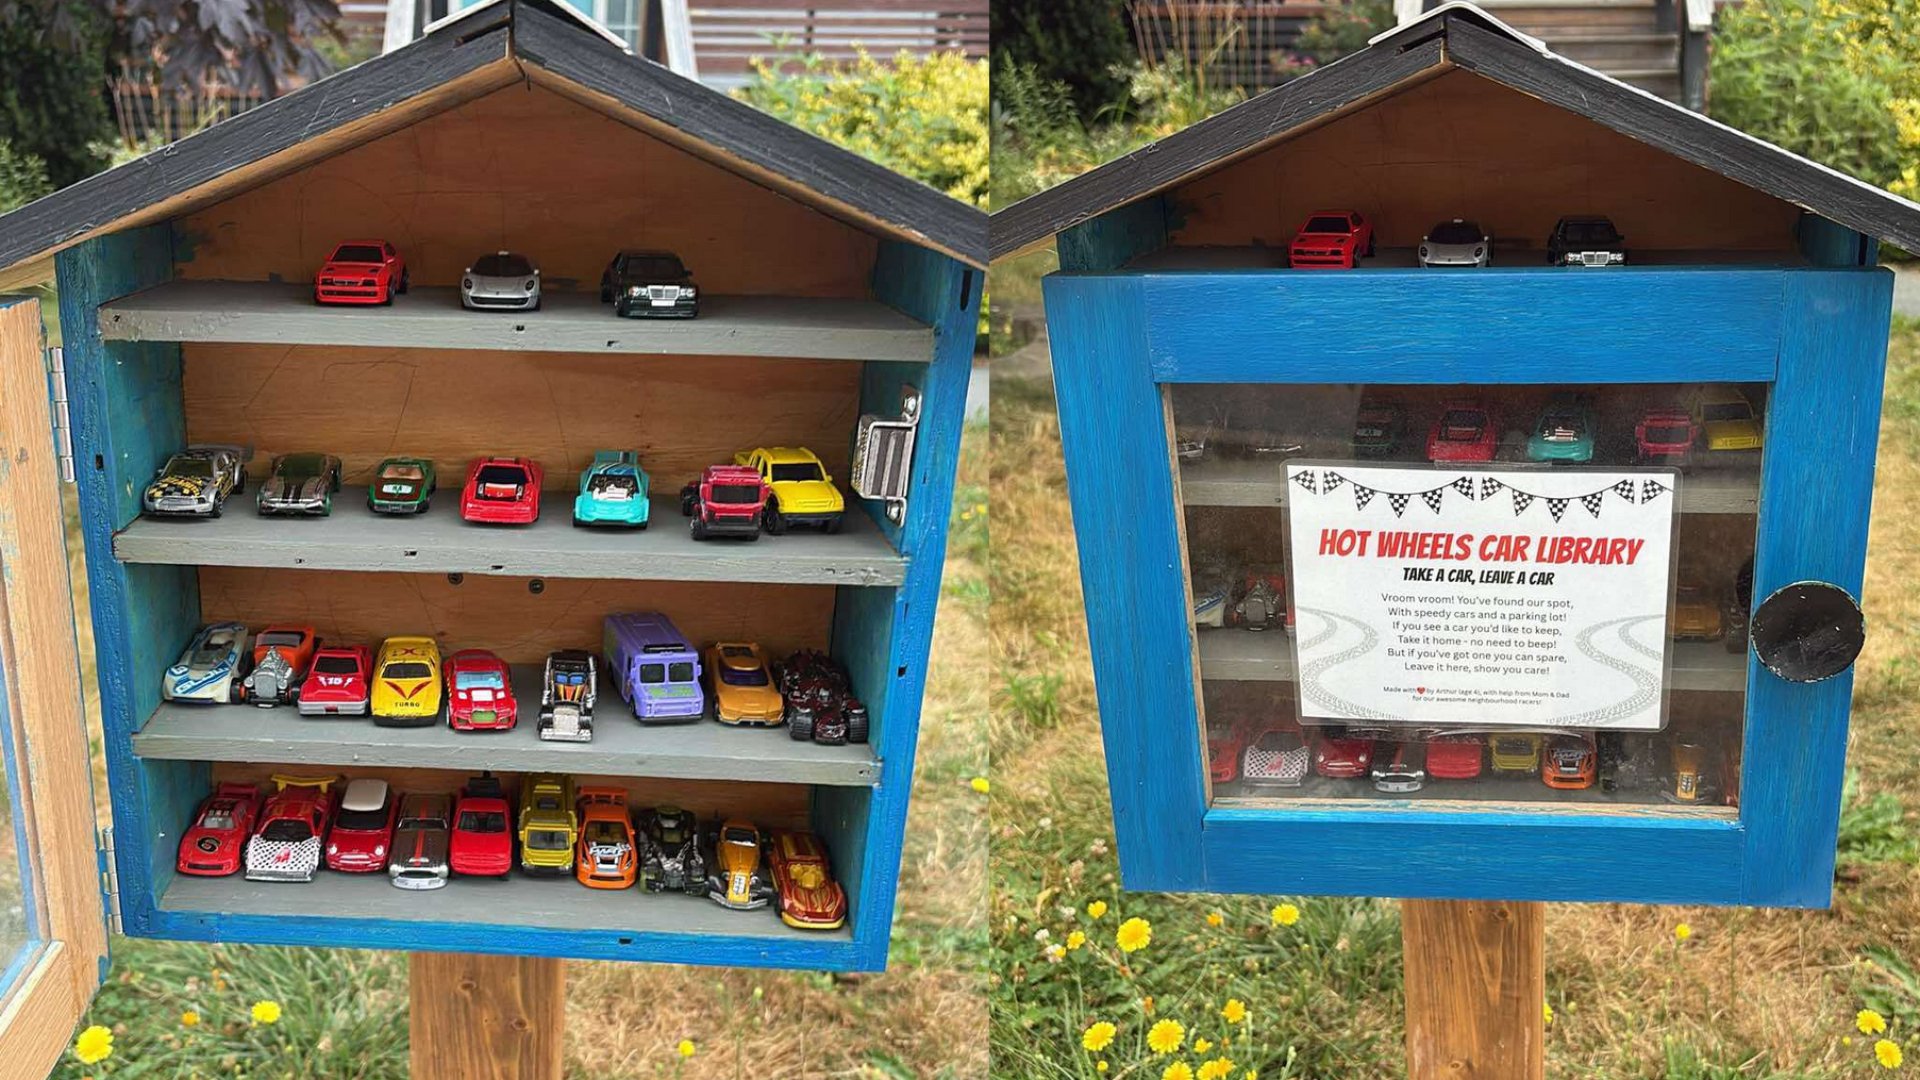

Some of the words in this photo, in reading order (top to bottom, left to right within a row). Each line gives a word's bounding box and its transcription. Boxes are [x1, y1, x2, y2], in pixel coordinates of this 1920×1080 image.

[1319, 529, 1371, 556] HOT
[1378, 531, 1474, 561] WHEELS
[1478, 535, 1532, 562] CAR
[1537, 537, 1644, 565] LIBRARY
[1403, 568, 1433, 582] TAKE
[1436, 568, 1444, 582] A
[1448, 569, 1476, 585] CAR,
[1479, 570, 1514, 584] LEAVE
[1517, 571, 1526, 584] A
[1529, 572, 1554, 585] CAR
[1381, 594, 1415, 603] Vroom
[1418, 595, 1454, 603] vroom!
[1457, 596, 1491, 605] You've
[1493, 597, 1524, 606] found
[1527, 599, 1544, 607] our
[1547, 599, 1574, 609] spot,
[1388, 608, 1411, 617] With
[1414, 609, 1451, 619] speedy
[1478, 611, 1497, 619] and
[1509, 612, 1547, 622] parking
[1550, 613, 1567, 622] lot!
[1393, 621, 1400, 629] If
[1402, 623, 1421, 632] you
[1471, 624, 1499, 635] you'd
[1502, 625, 1518, 634] like
[1398, 635, 1420, 644] Take
[1423, 636, 1429, 644] it
[1433, 637, 1461, 645] home
[1486, 639, 1511, 647] need
[1514, 640, 1525, 648] to
[1528, 640, 1556, 649] beep!
[1388, 648, 1405, 657] But
[1408, 649, 1415, 657] if
[1418, 649, 1450, 660] you've
[1453, 651, 1469, 660] got
[1494, 653, 1512, 662] you
[1536, 655, 1567, 663] spare,
[1405, 662, 1434, 671] Leave
[1437, 663, 1444, 671] it
[1446, 663, 1471, 673] here,
[1474, 664, 1500, 673] show
[1503, 667, 1521, 675] you
[1524, 666, 1549, 675] care!
